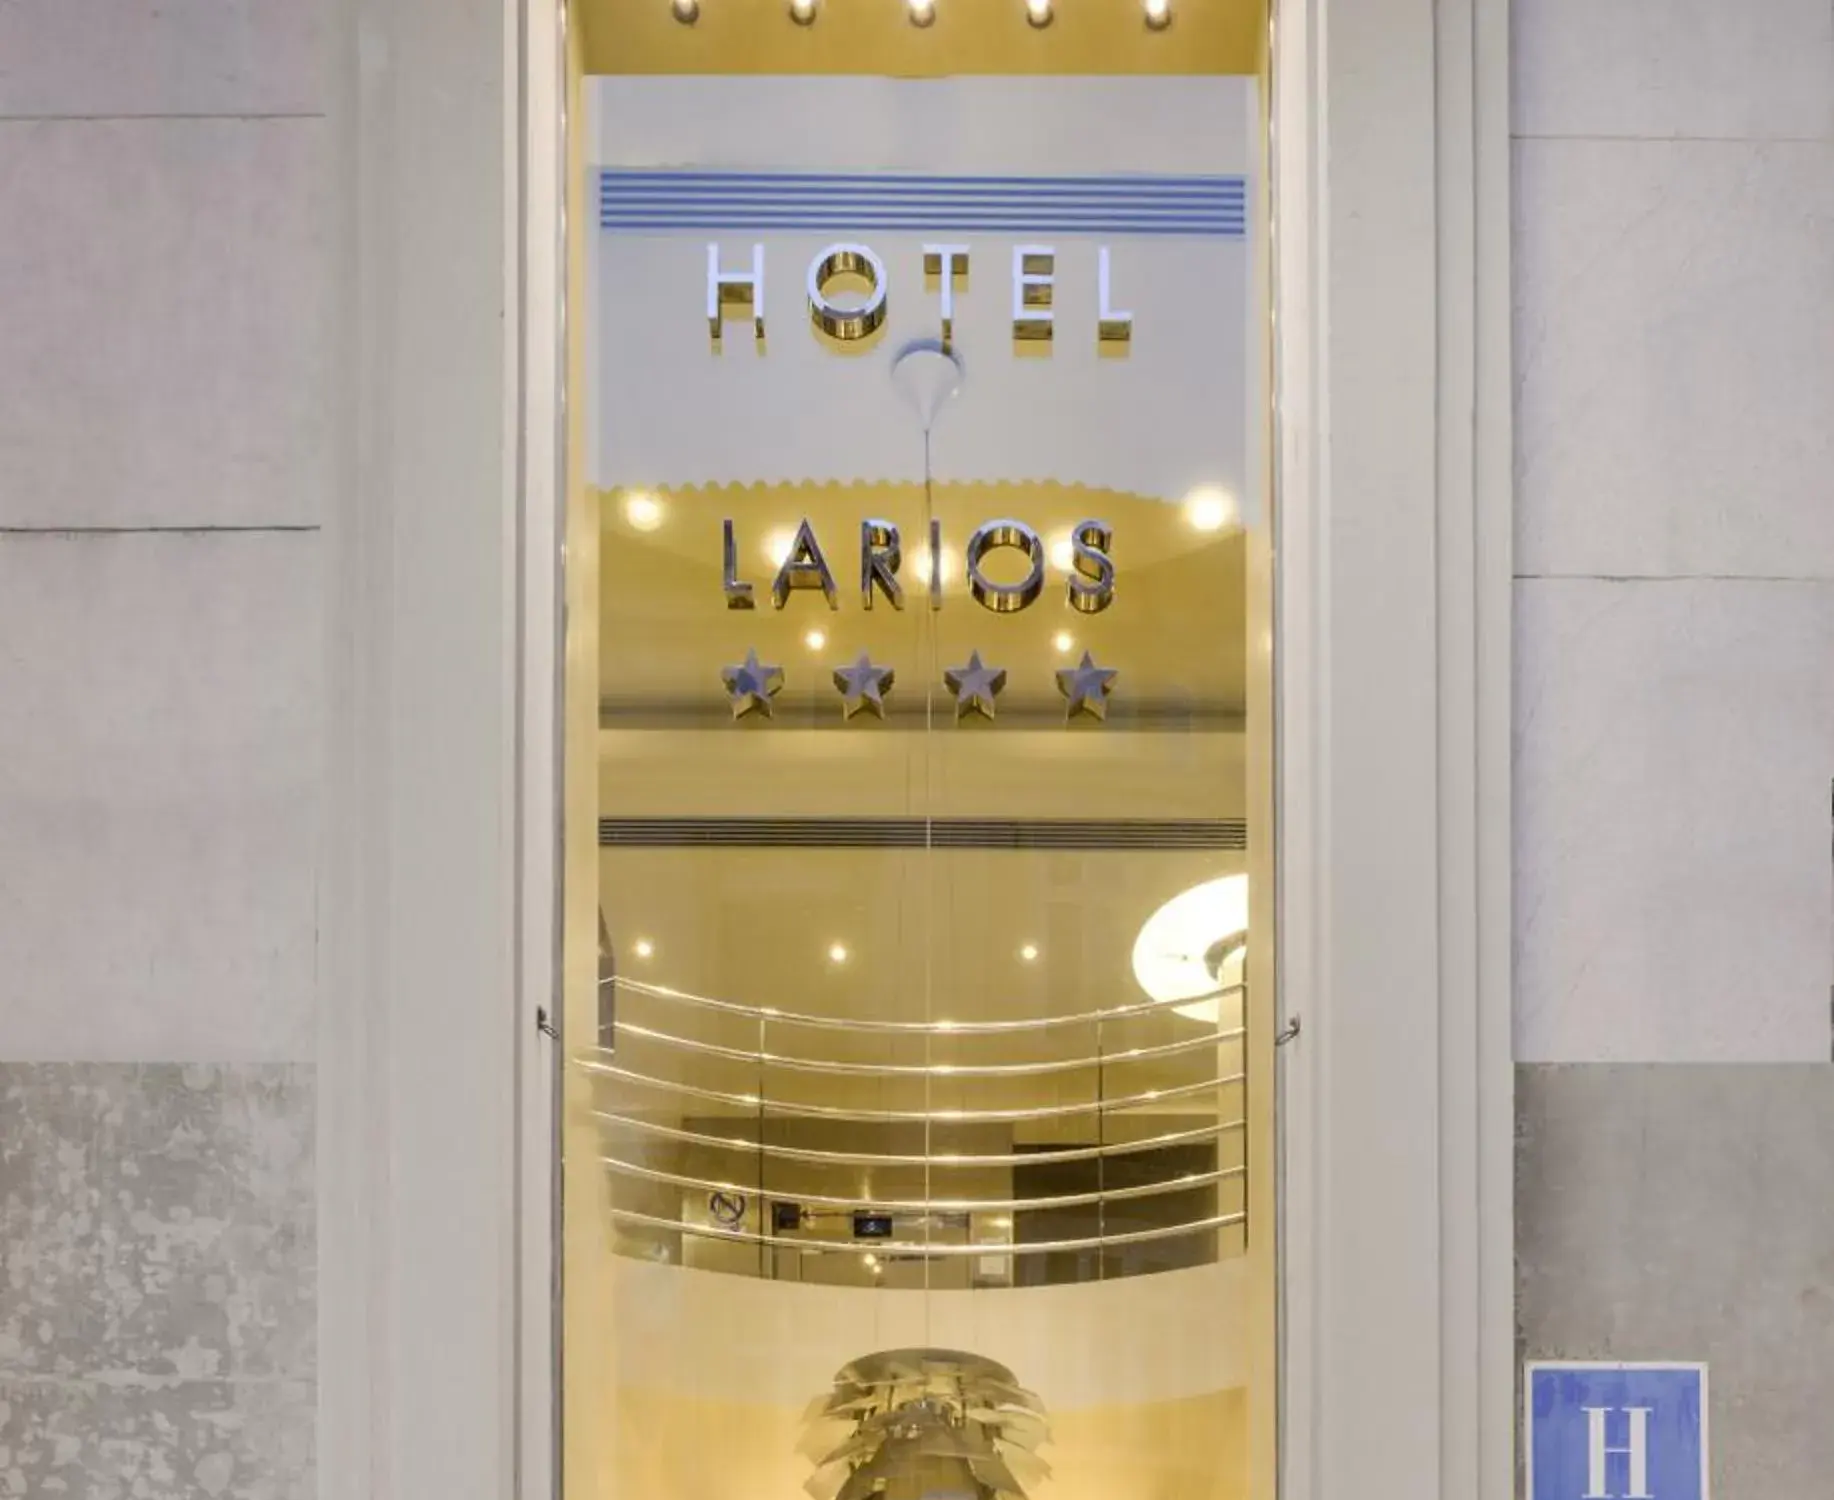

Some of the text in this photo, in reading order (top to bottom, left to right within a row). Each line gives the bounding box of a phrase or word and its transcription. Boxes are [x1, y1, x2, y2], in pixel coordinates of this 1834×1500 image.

[706, 243, 1134, 340] HOTEL
[721, 517, 1115, 614] LARIOS
[1580, 1406, 1655, 1500] H
